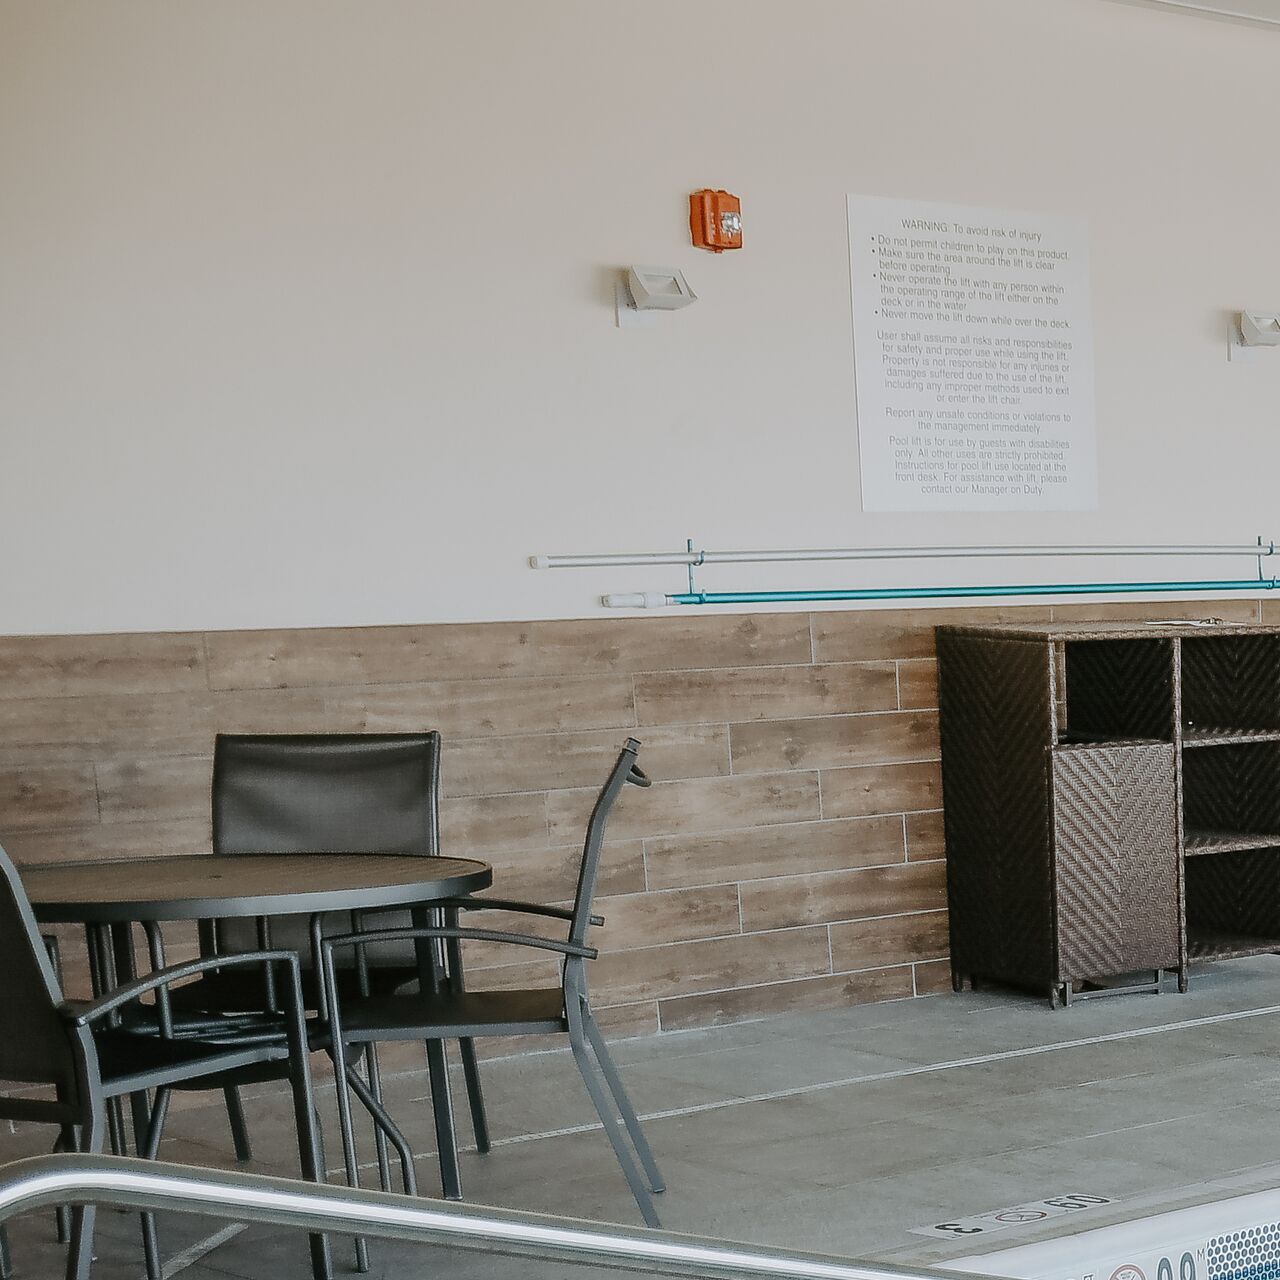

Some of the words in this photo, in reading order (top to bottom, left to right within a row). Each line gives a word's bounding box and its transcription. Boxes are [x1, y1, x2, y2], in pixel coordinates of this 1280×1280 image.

[953, 223, 963, 233] To
[966, 227, 988, 236] avoid
[991, 227, 1006, 237] risk
[1008, 229, 1017, 238] of
[1019, 231, 1041, 243] injury
